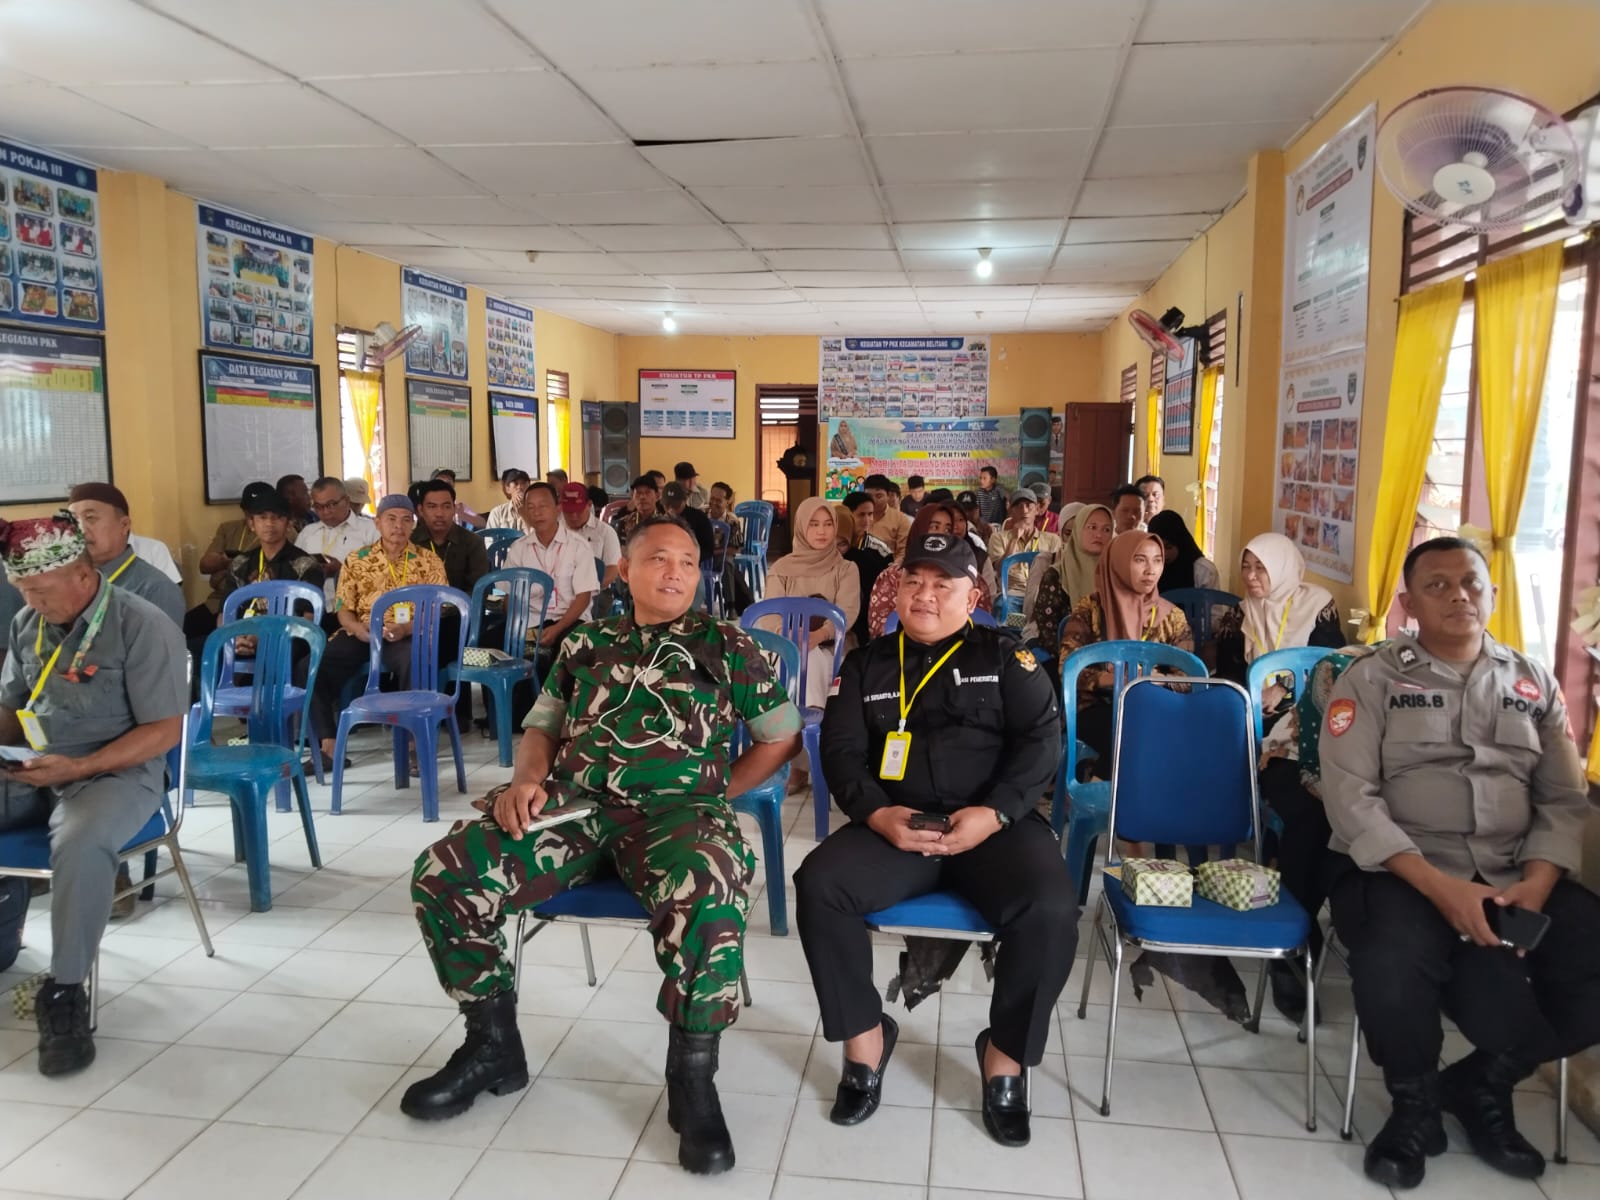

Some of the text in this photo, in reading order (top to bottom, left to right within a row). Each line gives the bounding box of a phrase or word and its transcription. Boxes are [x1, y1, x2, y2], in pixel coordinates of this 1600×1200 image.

[10, 151, 48, 173] POKJA
[51, 163, 63, 177] III
[225, 218, 261, 240] KEGIATAN
[263, 228, 286, 245] POKJA
[229, 363, 249, 376] DATA
[250, 365, 283, 380] KEGIATAN
[1388, 694, 1445, 710] ARIS.B
